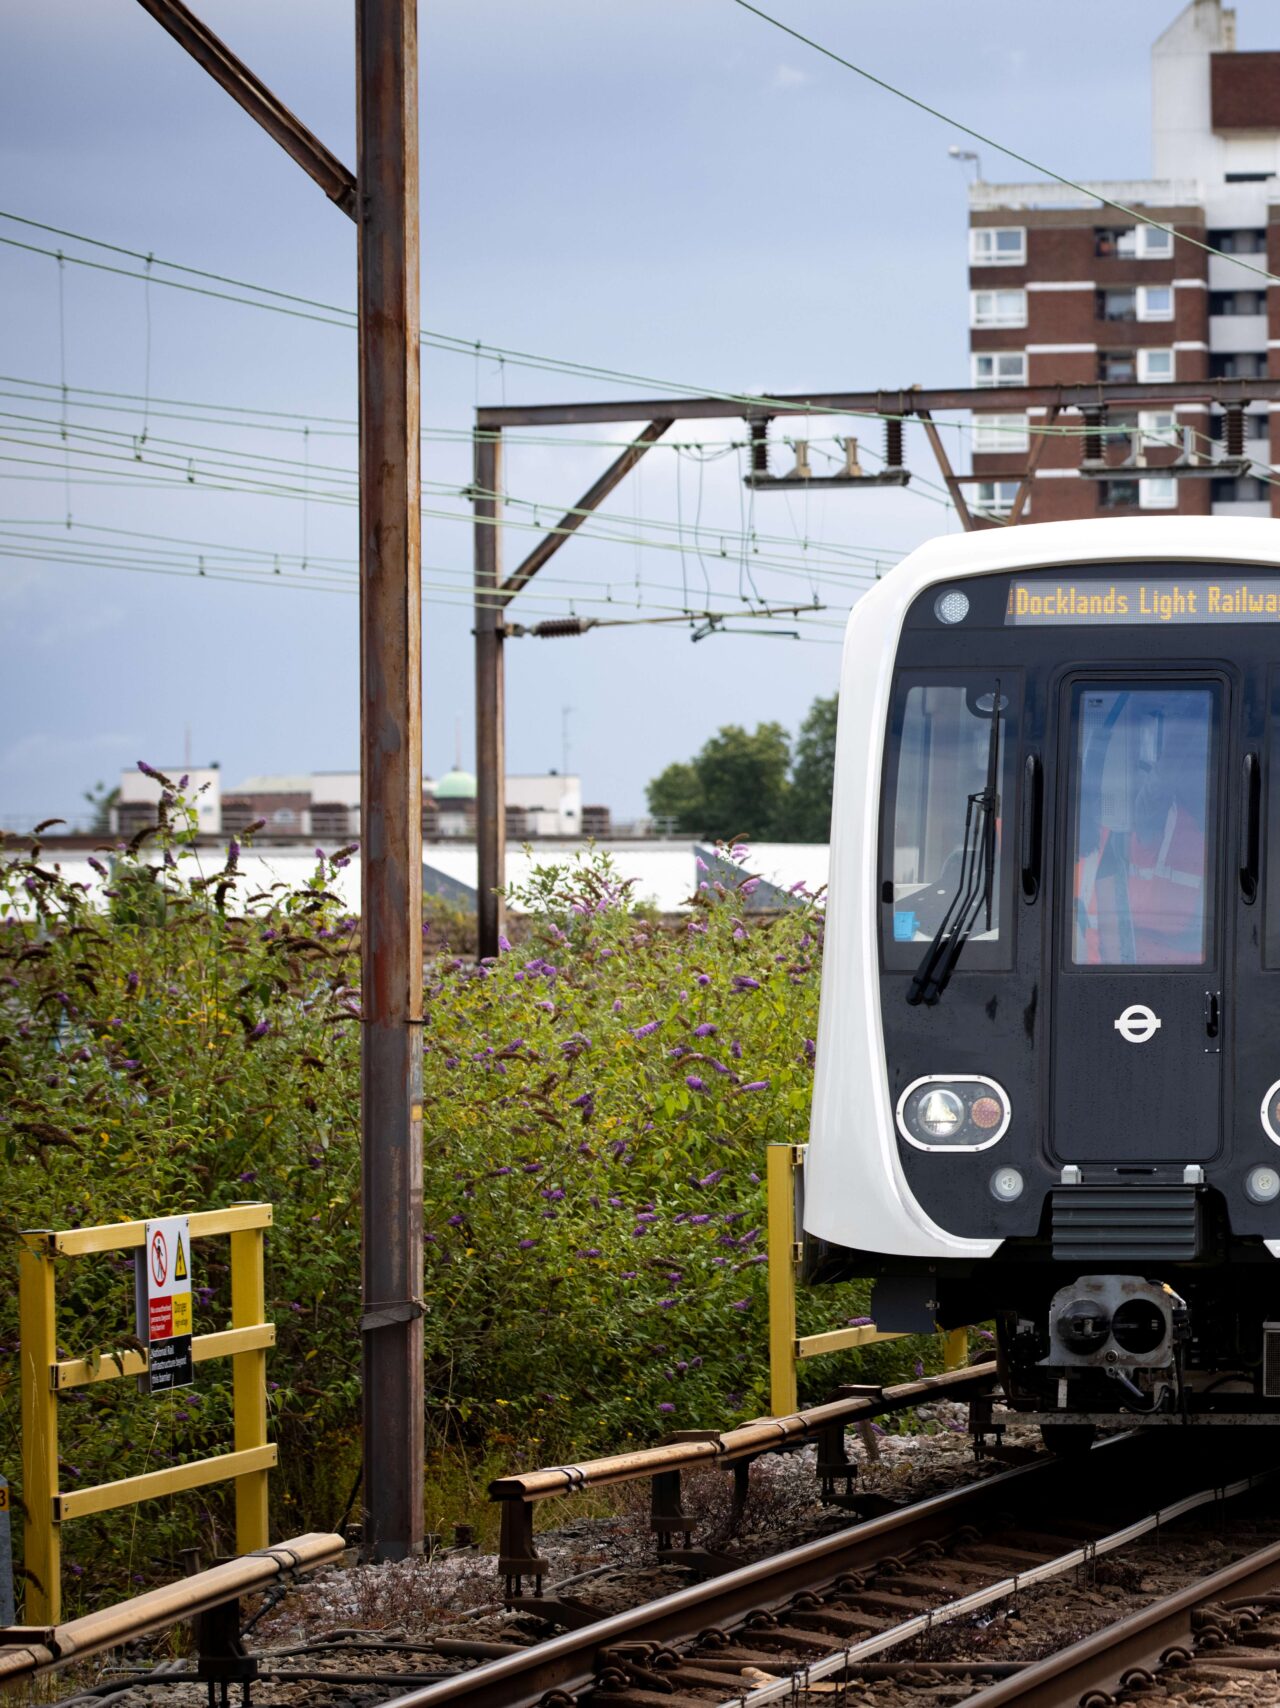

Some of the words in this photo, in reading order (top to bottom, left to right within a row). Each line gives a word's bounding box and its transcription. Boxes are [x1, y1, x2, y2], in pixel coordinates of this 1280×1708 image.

[1015, 586, 1128, 615] Docklands
[1140, 586, 1197, 620] Light
[151, 1346, 166, 1358] National
[167, 1344, 175, 1355] Rail
